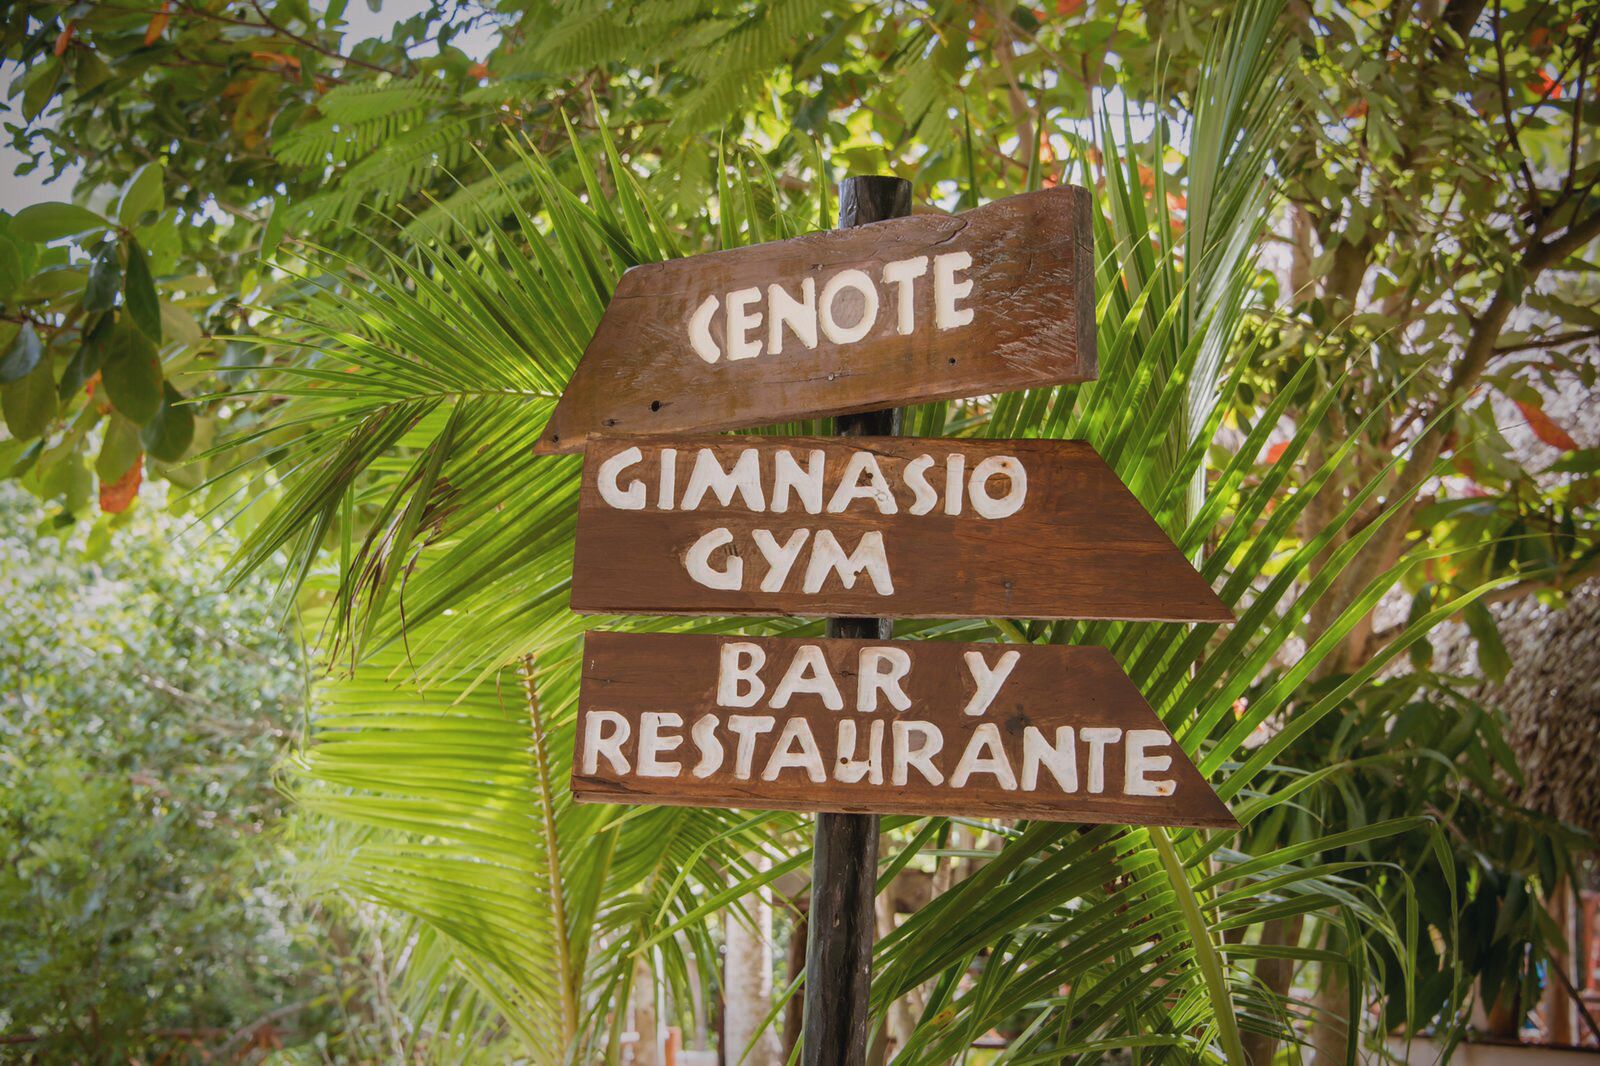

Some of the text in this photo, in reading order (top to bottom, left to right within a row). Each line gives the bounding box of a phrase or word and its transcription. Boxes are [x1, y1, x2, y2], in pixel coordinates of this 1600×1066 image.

[687, 250, 975, 364] CENOTE
[596, 445, 1028, 520] GIMNASIO
[685, 527, 895, 596] GYM
[716, 642, 1021, 716] BAR Y
[582, 710, 1177, 797] RESTAURANTE
